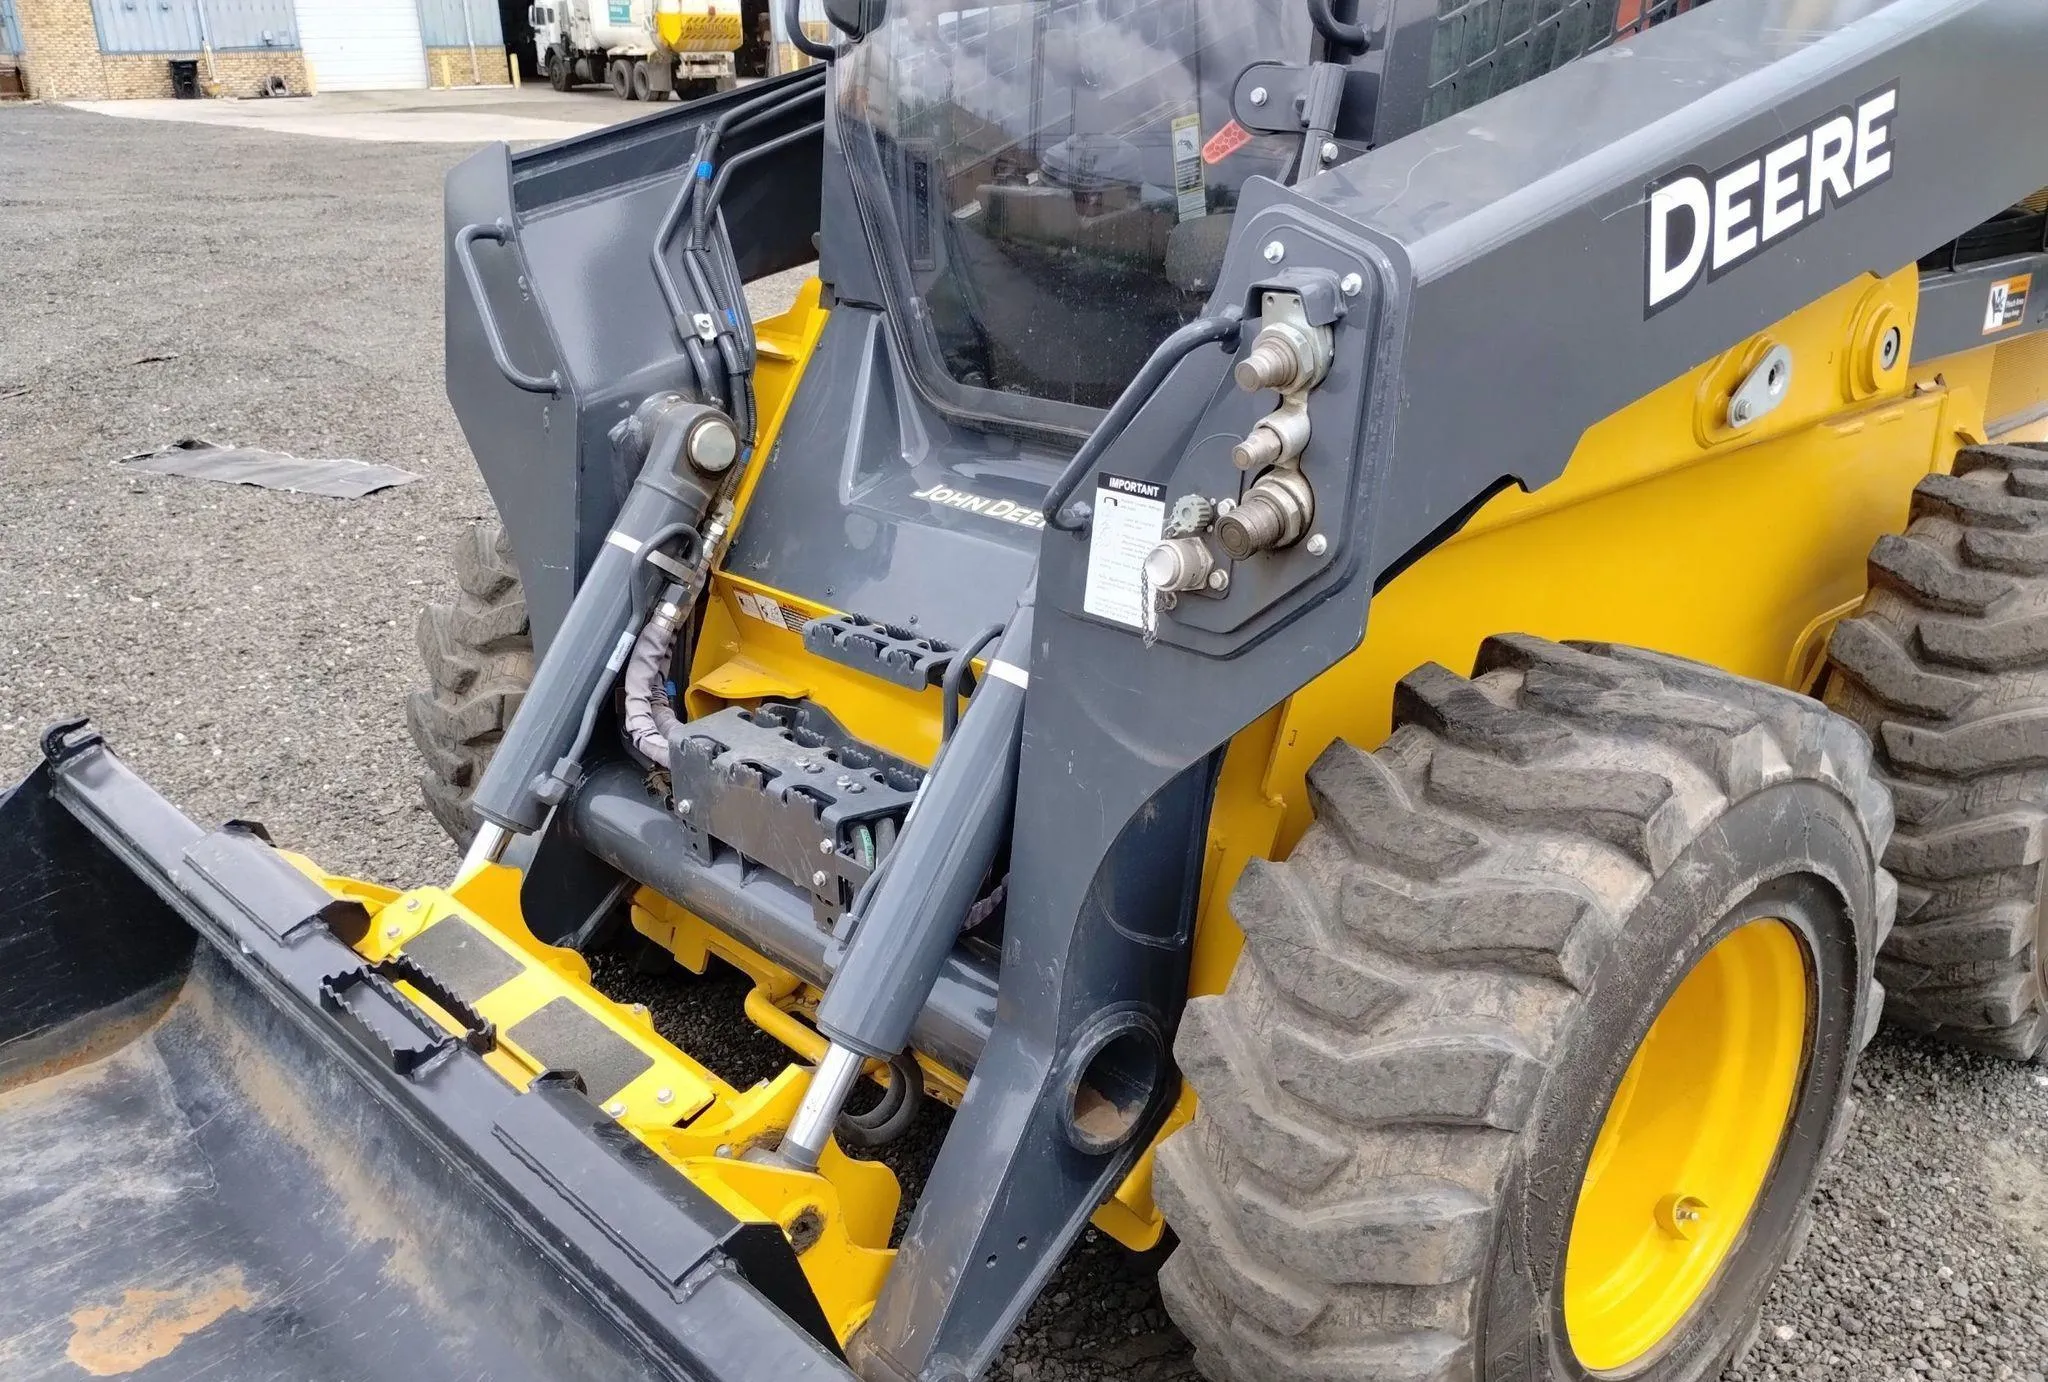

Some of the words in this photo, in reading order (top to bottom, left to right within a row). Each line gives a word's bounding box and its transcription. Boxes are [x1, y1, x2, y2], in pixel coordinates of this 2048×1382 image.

[1649, 89, 1896, 306] DEERE
[913, 484, 992, 513] JOHN
[985, 500, 1046, 527] DEE
[1109, 477, 1160, 498] IMPORTANT
